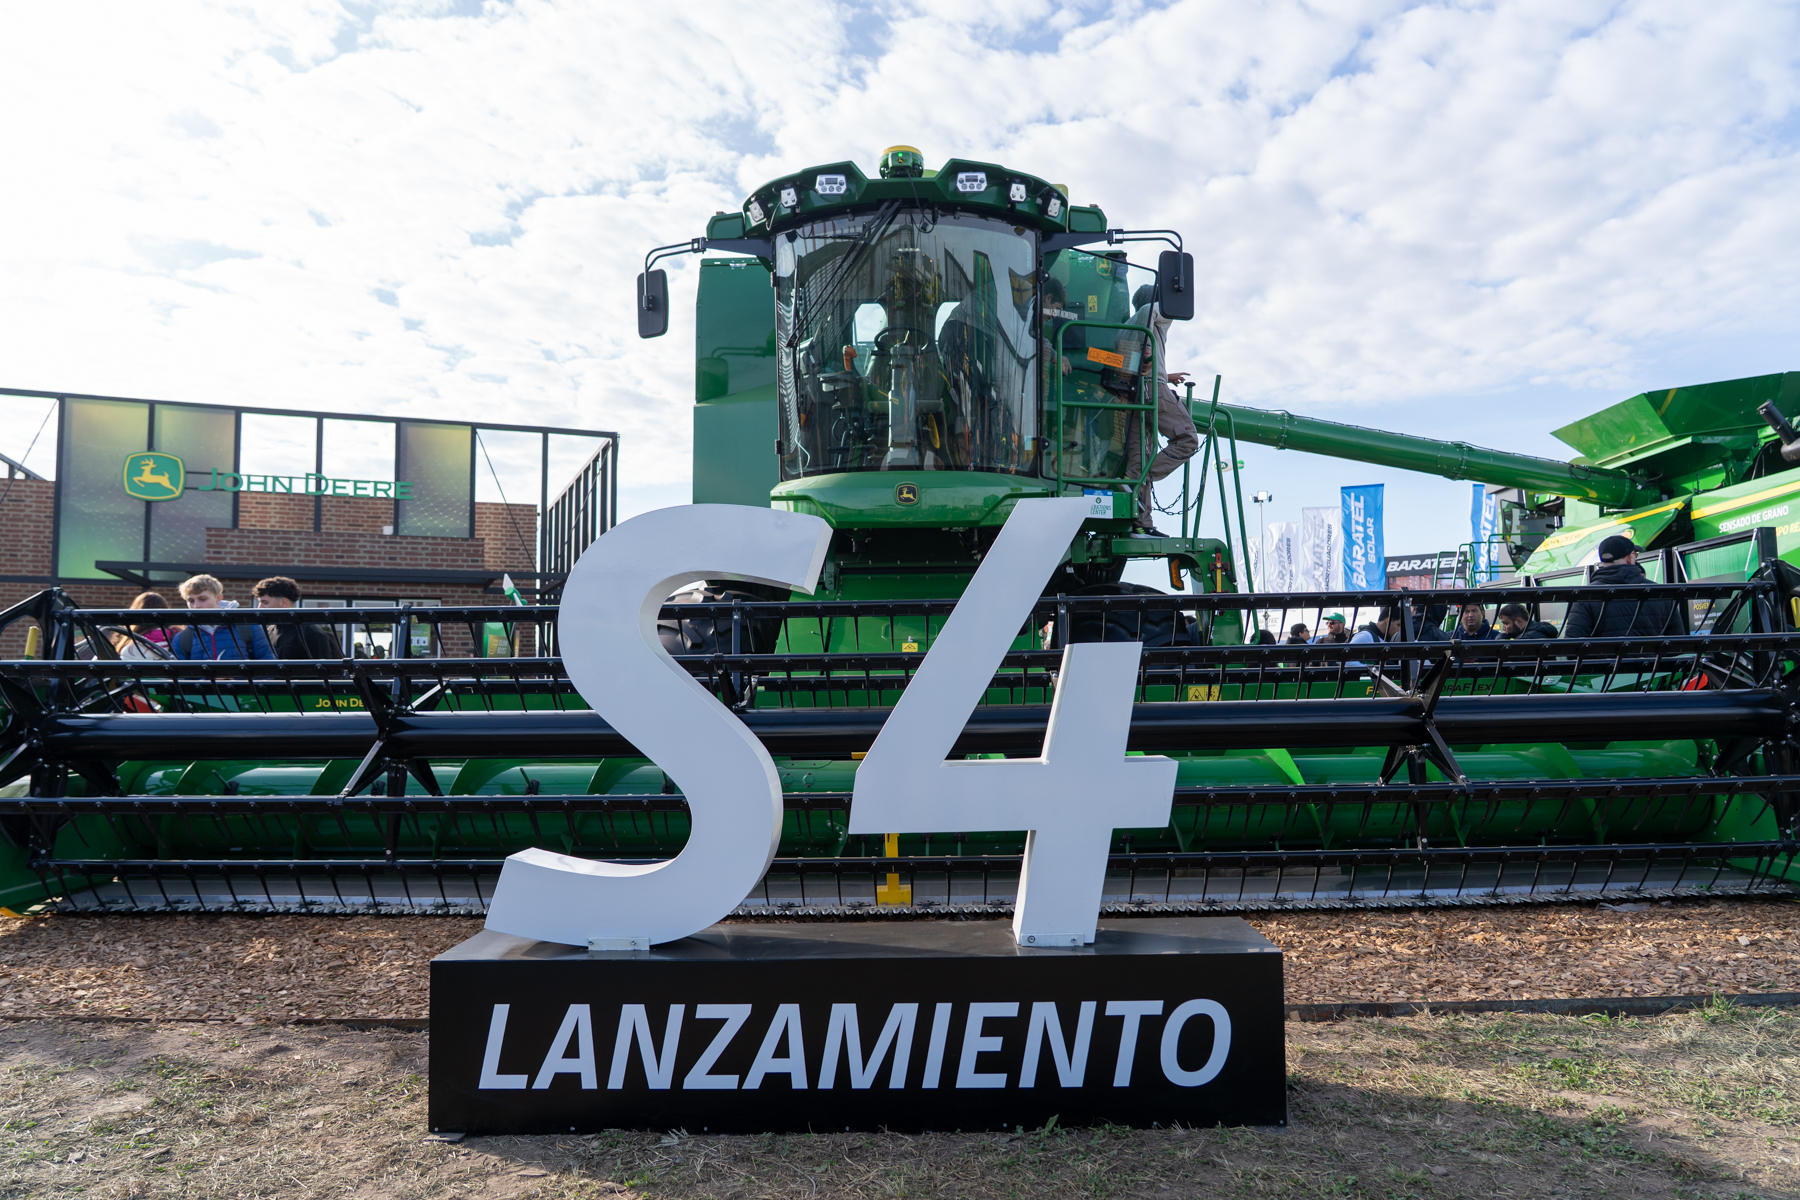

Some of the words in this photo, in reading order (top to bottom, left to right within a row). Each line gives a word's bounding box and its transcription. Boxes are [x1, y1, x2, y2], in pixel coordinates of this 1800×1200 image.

[198, 468, 293, 494] JOHN
[305, 473, 414, 500] DEERE
[1718, 516, 1751, 533] SENSADO
[1751, 512, 1762, 524] DE
[1762, 505, 1789, 521] GRANO
[1350, 492, 1367, 589] BARATEC
[1366, 517, 1375, 564] SOLAR
[1386, 556, 1463, 573] BARATEC
[477, 998, 1233, 1091] LANZAMIENTO
